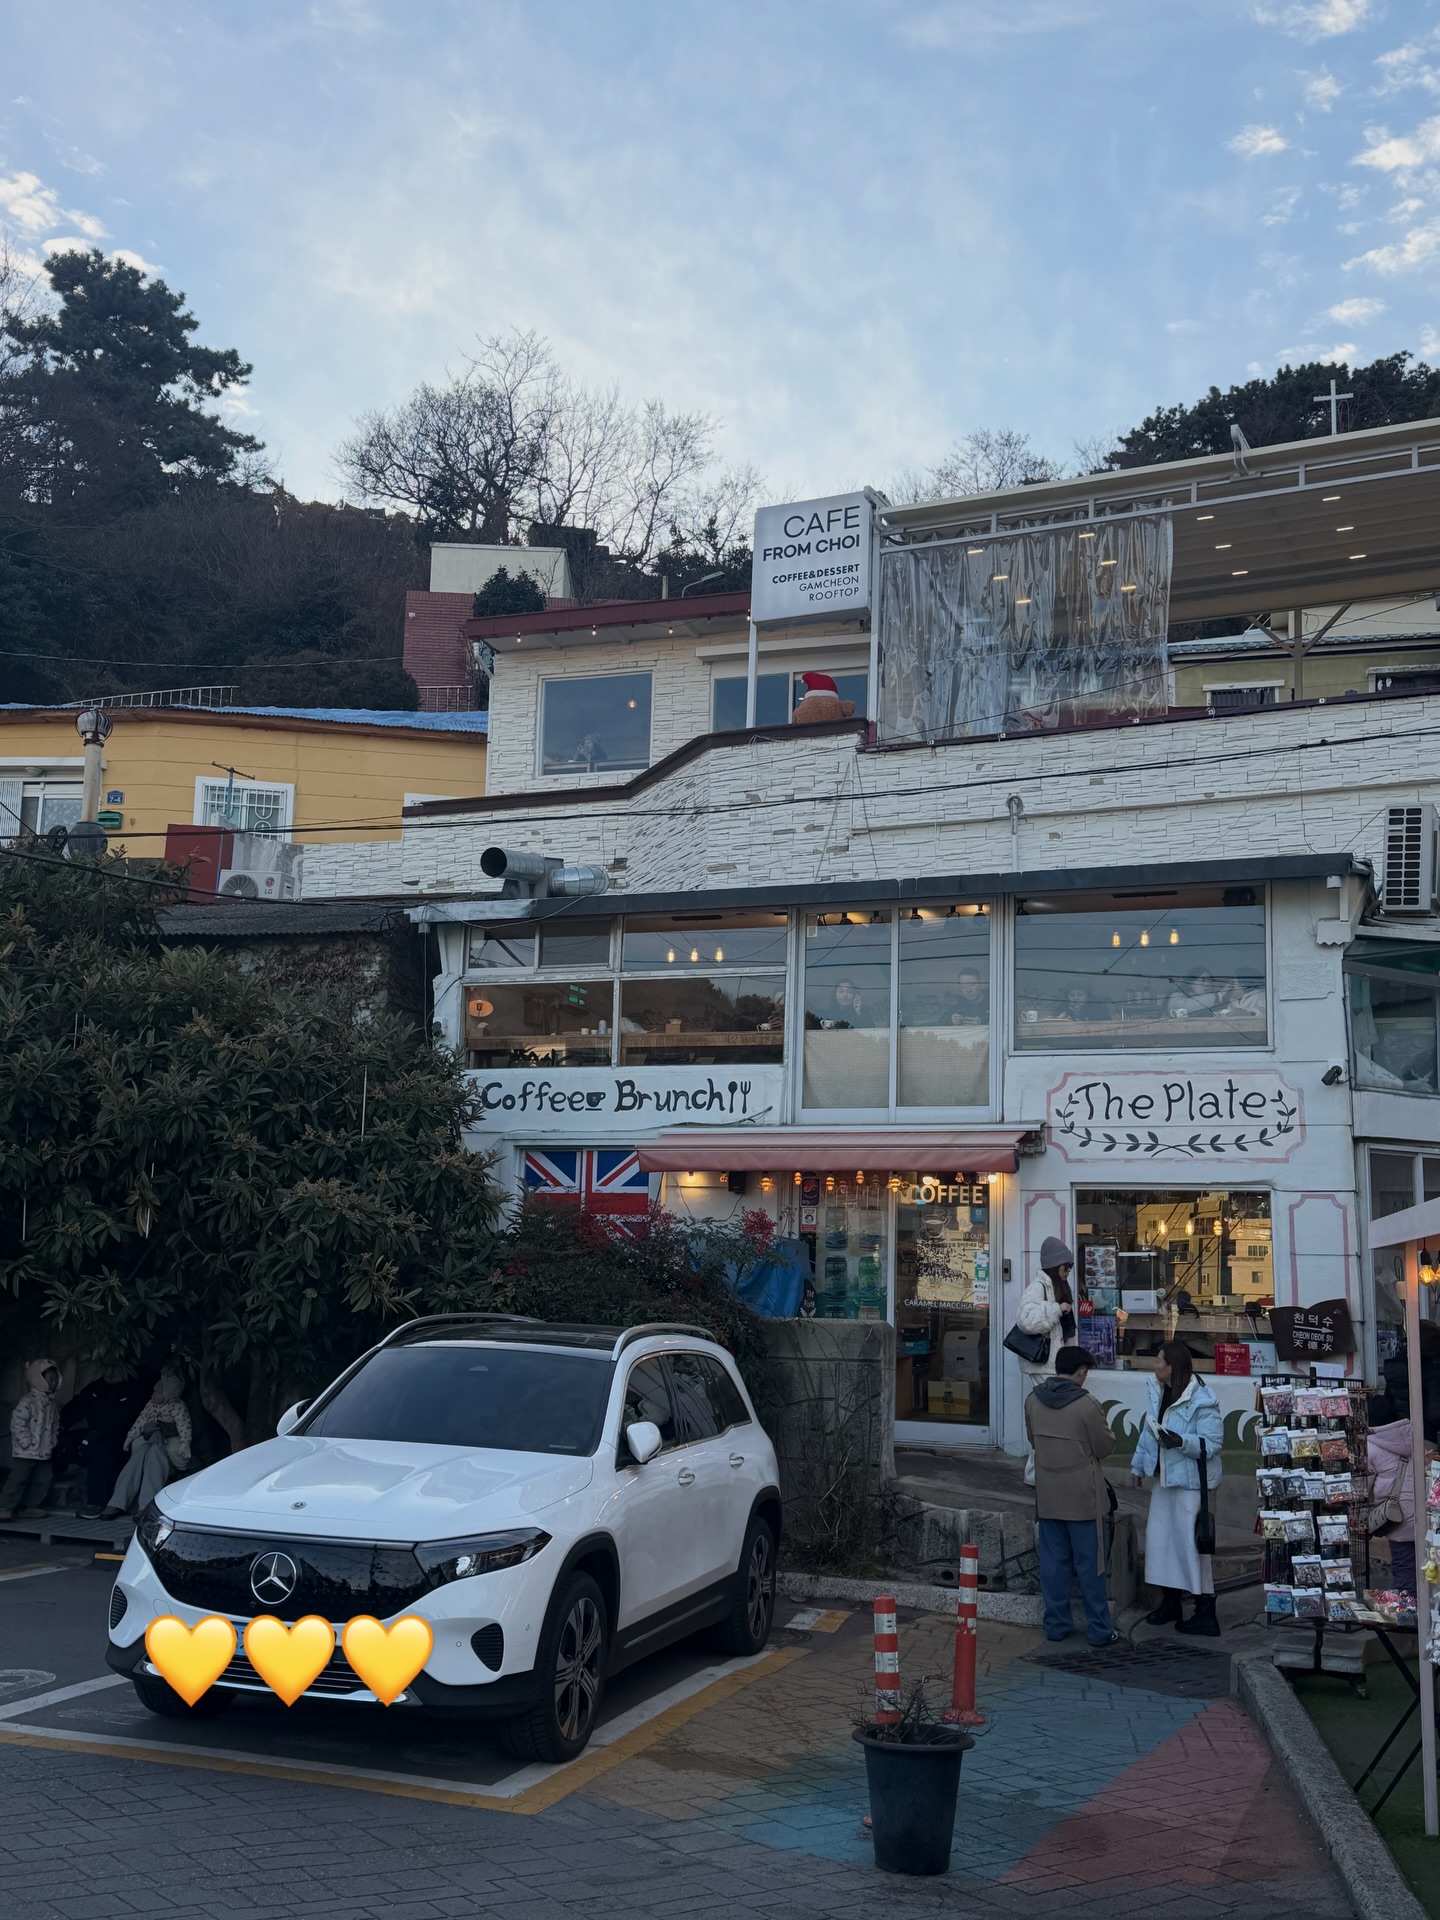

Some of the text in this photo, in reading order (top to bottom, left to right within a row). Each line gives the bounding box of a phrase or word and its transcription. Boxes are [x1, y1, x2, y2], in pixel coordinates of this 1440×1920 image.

[783, 505, 861, 538] CAFE
[763, 534, 860, 561] FROM CHOI
[772, 564, 860, 584] COFFEE&DESSERT
[799, 576, 859, 592] GAMCHEON
[809, 587, 860, 602] ROOFTOP
[481, 1078, 725, 1112] Coffee Brunch
[1075, 1079, 1267, 1122] The Plate
[907, 1184, 983, 1204] COFFEE
[904, 1299, 938, 1308] CARAMEL
[1080, 1302, 1092, 1312] illy
[1293, 1331, 1334, 1343] CHEON DEOK SU
